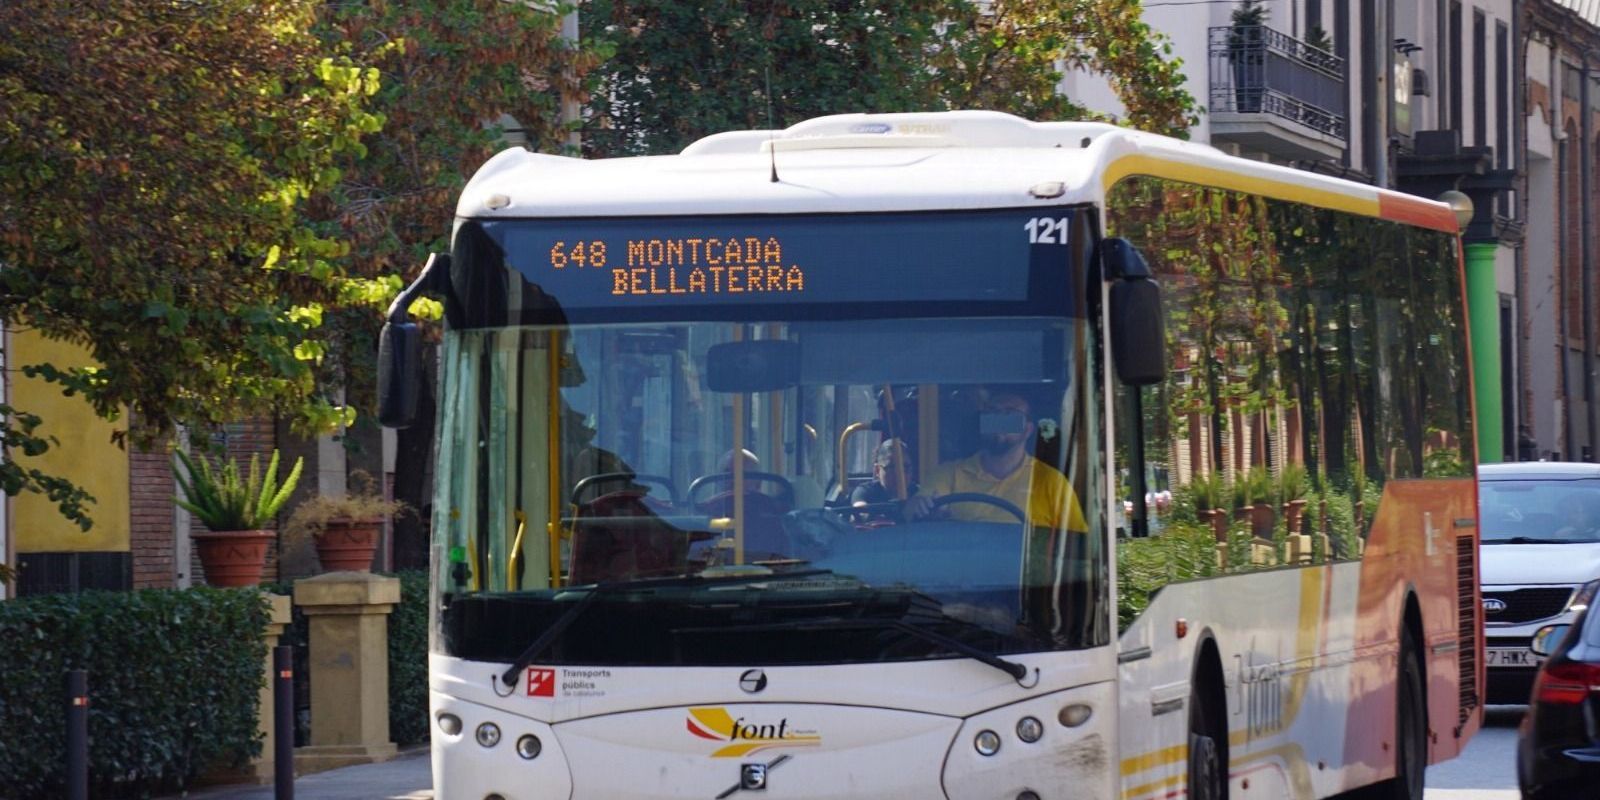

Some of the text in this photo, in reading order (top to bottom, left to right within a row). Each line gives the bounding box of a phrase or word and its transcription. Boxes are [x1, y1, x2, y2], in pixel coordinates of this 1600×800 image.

[1024, 217, 1068, 244] 121
[551, 237, 782, 268] 648 MONTCADA
[612, 265, 804, 294] BELLATERRA
[562, 669, 611, 678] Transports
[562, 680, 595, 690] públics
[730, 717, 787, 741] font
